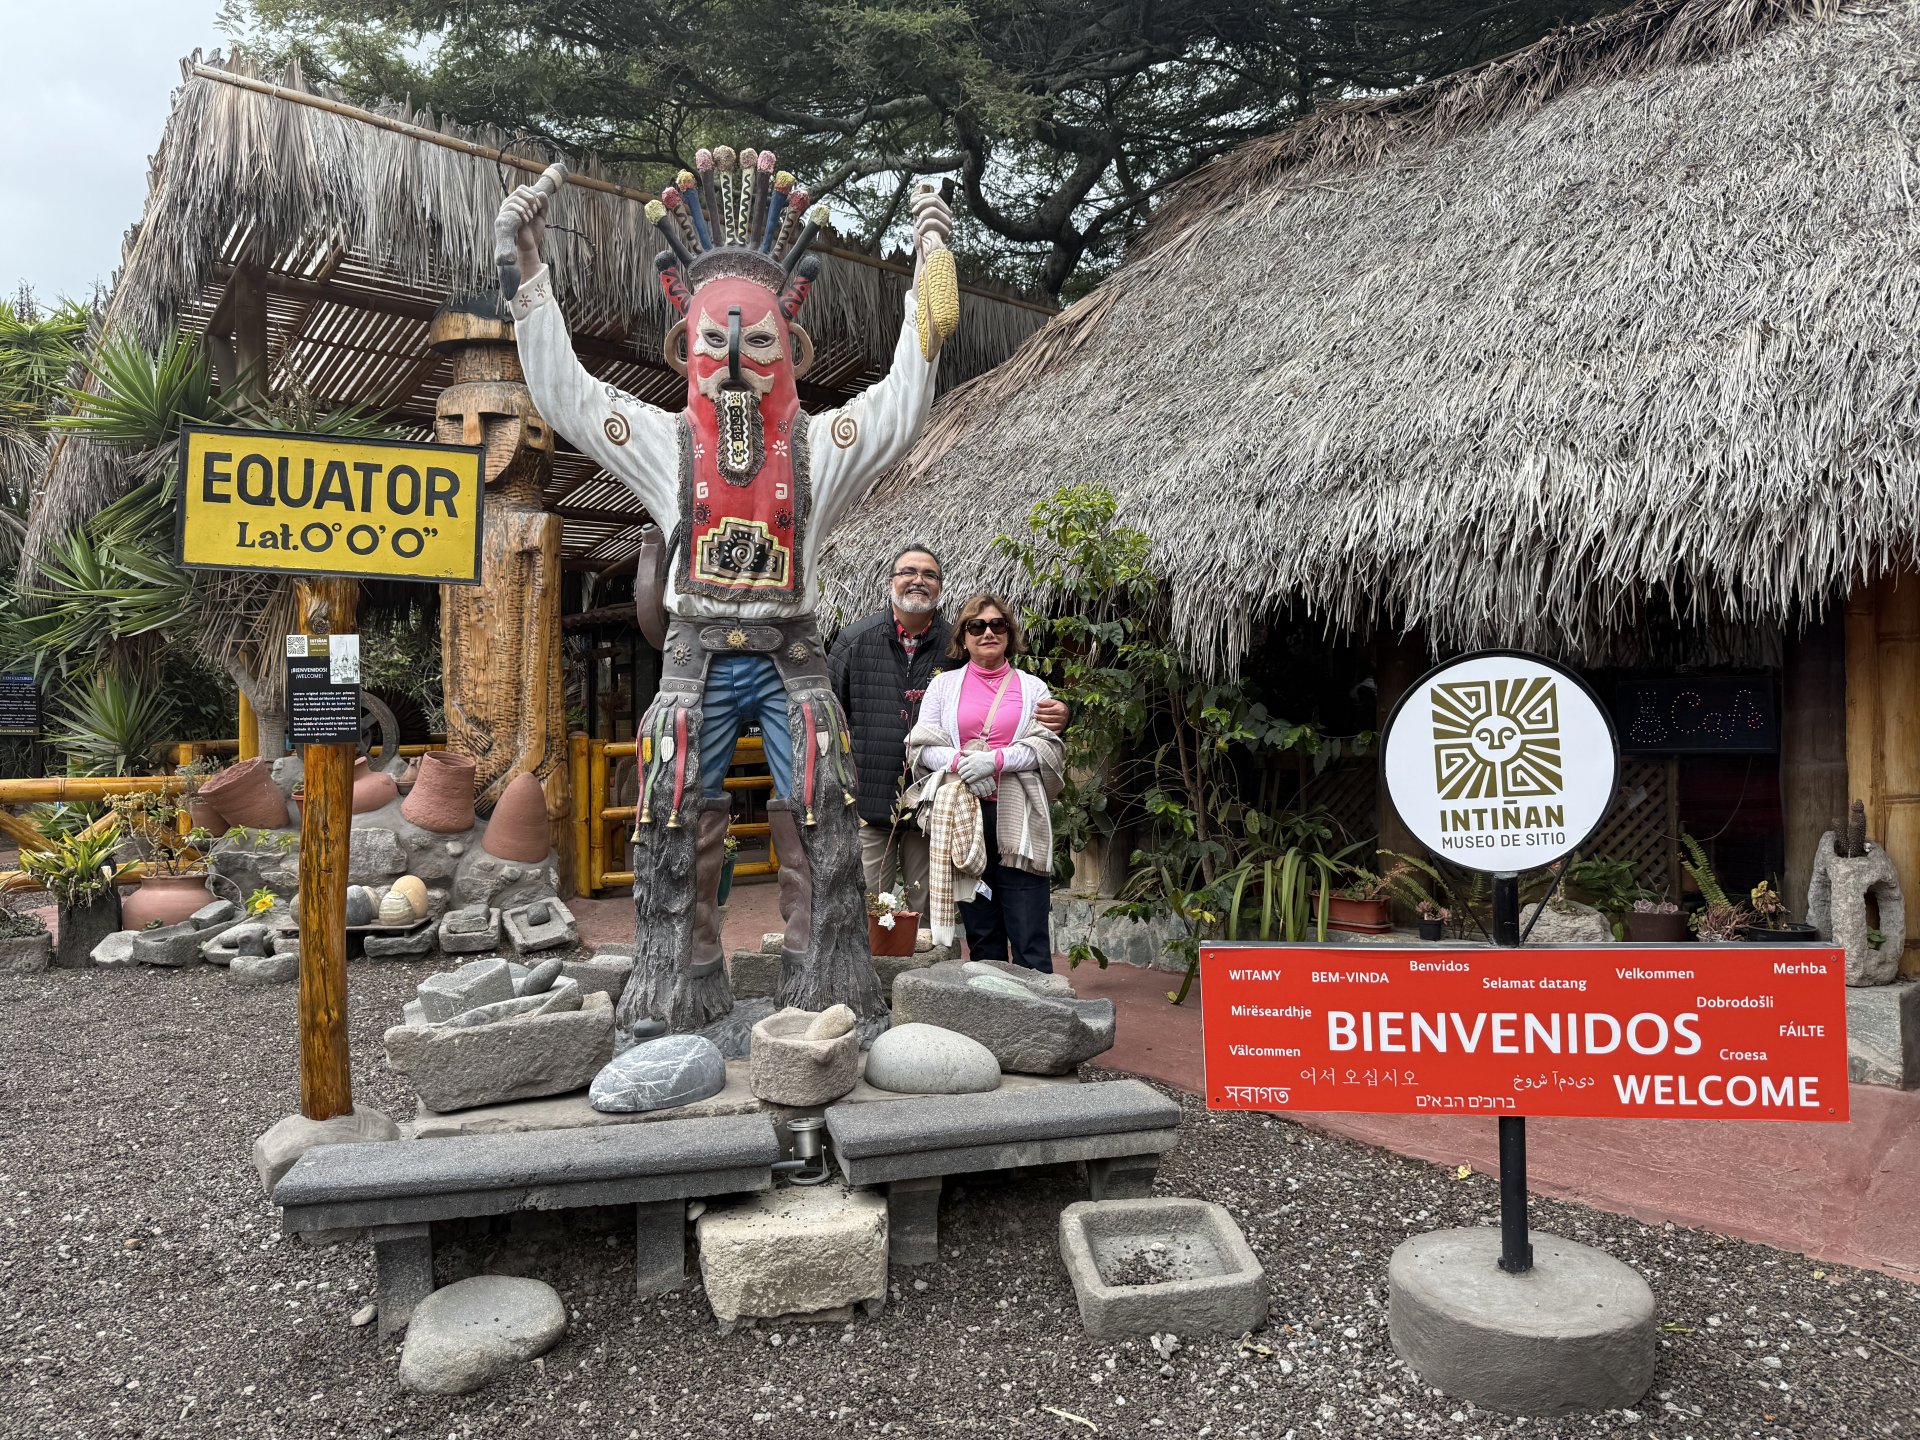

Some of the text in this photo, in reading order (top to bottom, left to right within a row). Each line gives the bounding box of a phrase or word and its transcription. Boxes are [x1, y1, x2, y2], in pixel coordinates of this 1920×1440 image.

[202, 452, 460, 518] EQUATOR
[1440, 800, 1565, 832] INTIÑAN
[1442, 832, 1566, 849] MUSEO DE SITIO
[1409, 960, 1470, 972] Benvidos
[1773, 962, 1828, 974] Merhba
[1229, 969, 1281, 981] WITAMY
[1311, 971, 1390, 984] BEM-VINDA
[1615, 967, 1695, 980] Velkommen
[1482, 977, 1587, 991] Selamat datang
[1696, 995, 1774, 1009] Dobrodošli
[1231, 1004, 1312, 1020] Mirëseardhje
[1327, 1010, 1702, 1055] BIENVENIDOS
[1779, 1020, 1825, 1037] FÁILTE
[1229, 1044, 1301, 1057] Välcommen
[1719, 1048, 1767, 1061] Croesa
[1300, 1066, 1419, 1087] 어서 오십시오
[1612, 1074, 1821, 1108] WELCOME
